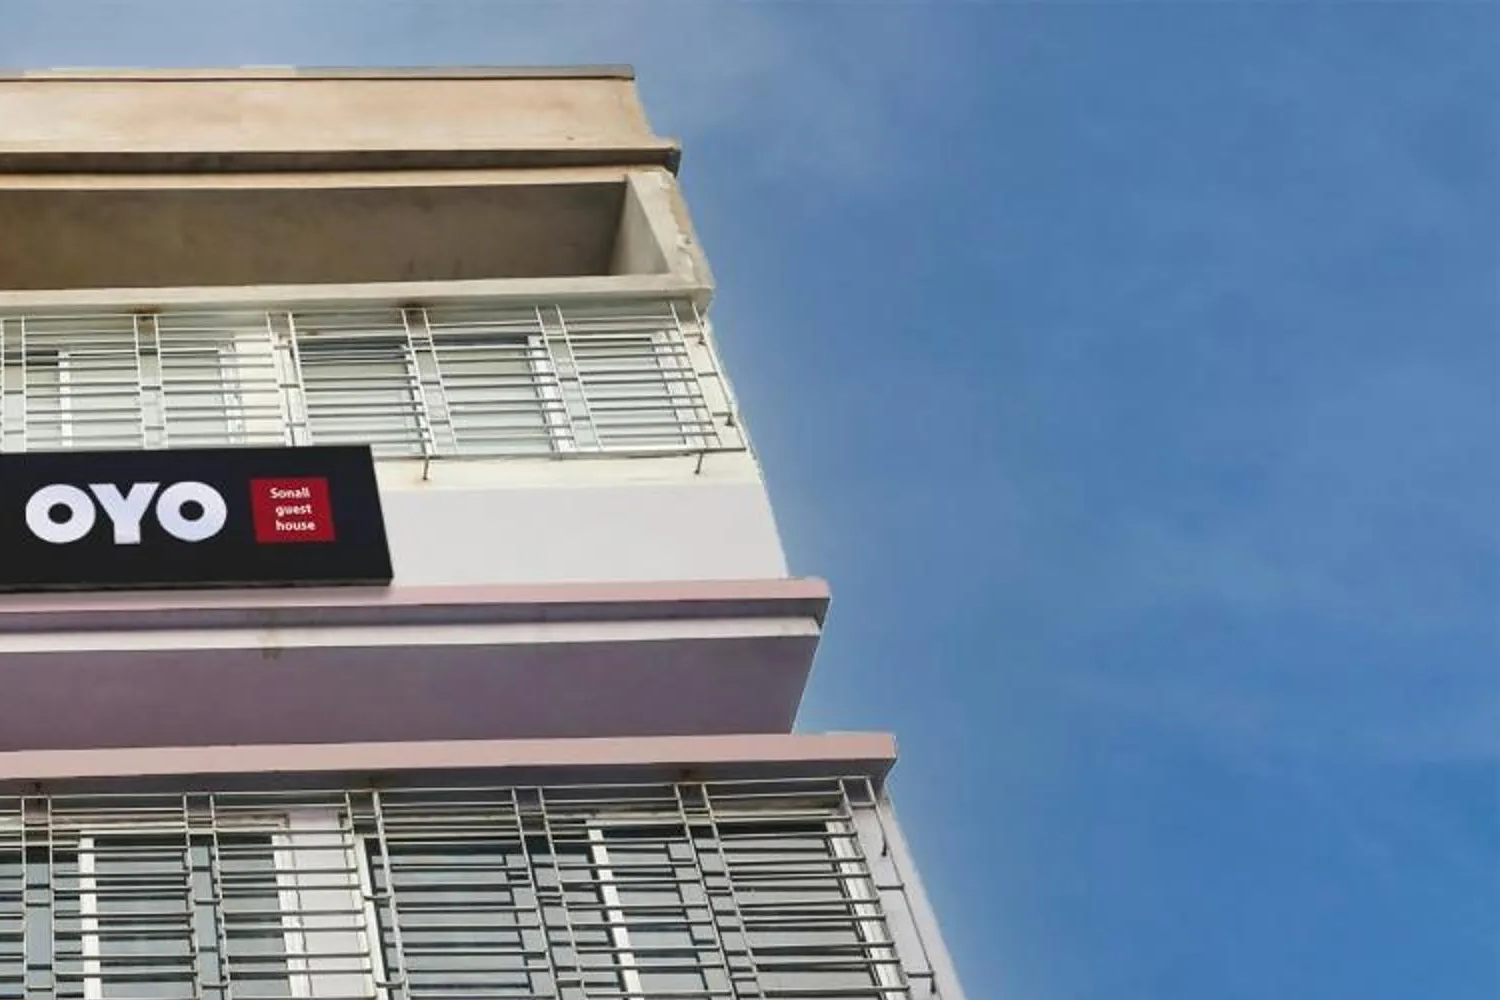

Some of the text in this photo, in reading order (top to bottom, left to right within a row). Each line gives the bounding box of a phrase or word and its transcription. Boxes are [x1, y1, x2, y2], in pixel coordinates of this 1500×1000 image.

[25, 482, 228, 544] OYO
[275, 504, 312, 517] guest
[275, 520, 316, 531] house
